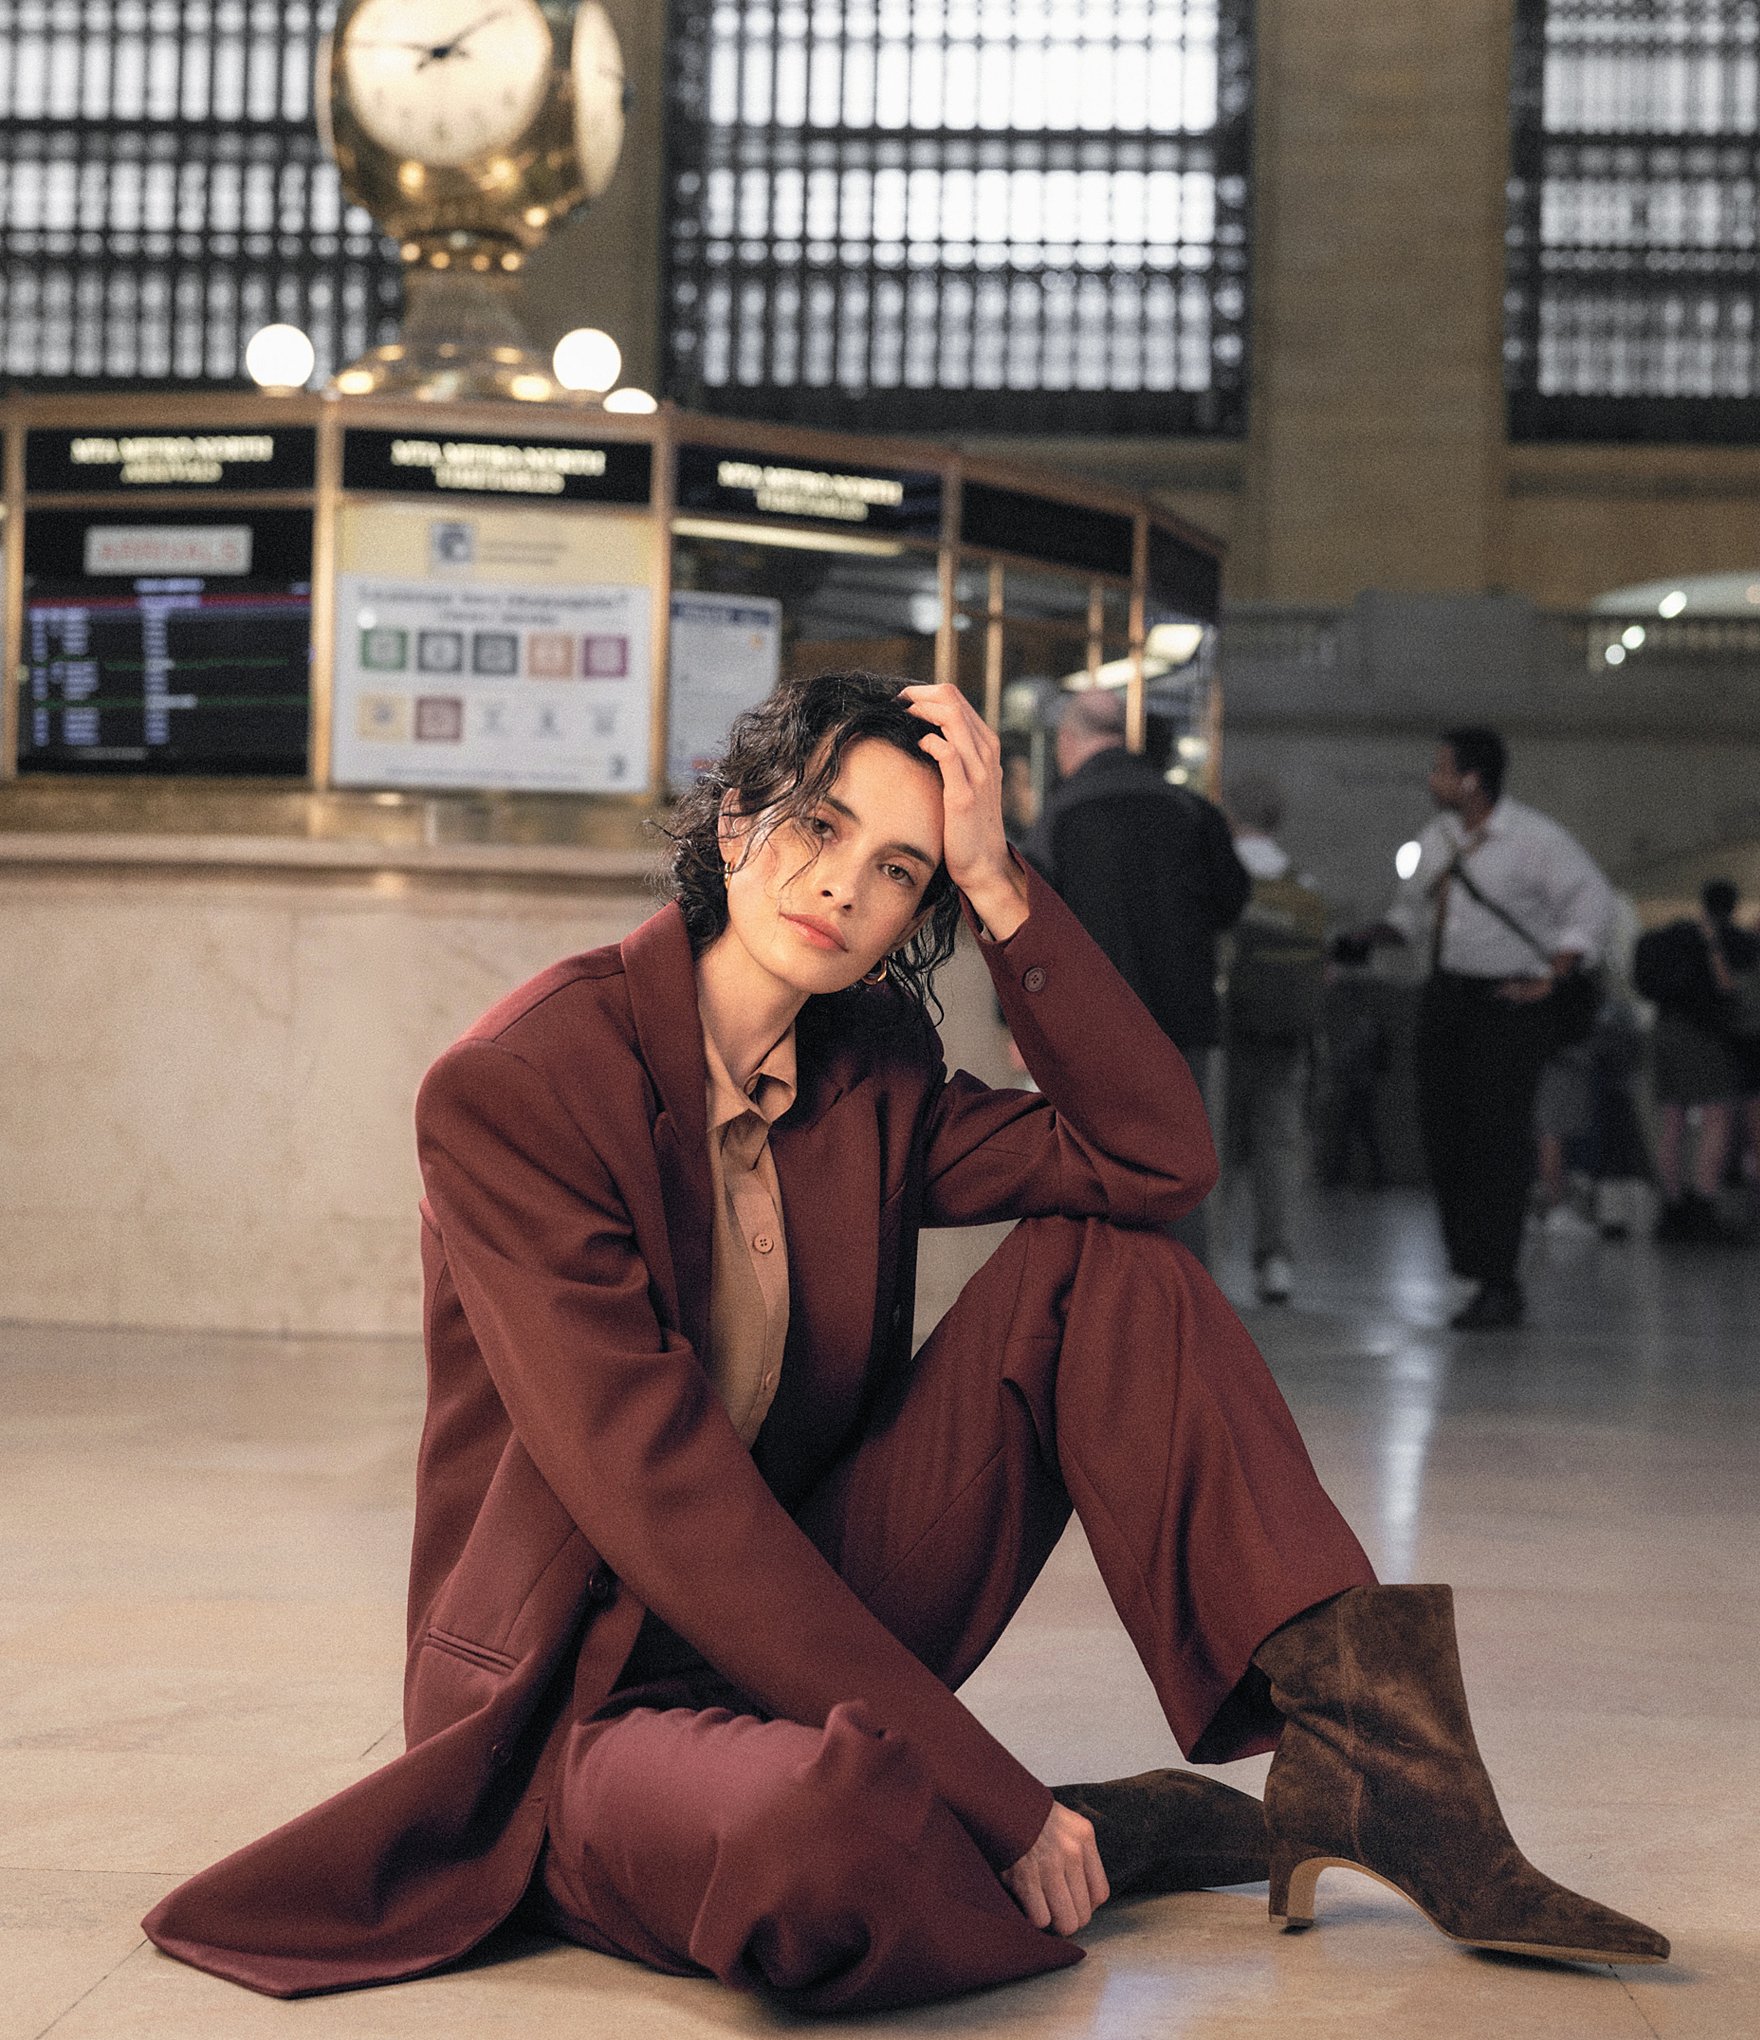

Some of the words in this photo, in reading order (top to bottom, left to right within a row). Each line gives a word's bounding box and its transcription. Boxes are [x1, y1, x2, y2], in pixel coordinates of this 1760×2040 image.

[71, 437, 118, 464] MTA
[391, 439, 440, 467] MTA
[718, 461, 762, 489] MTA
